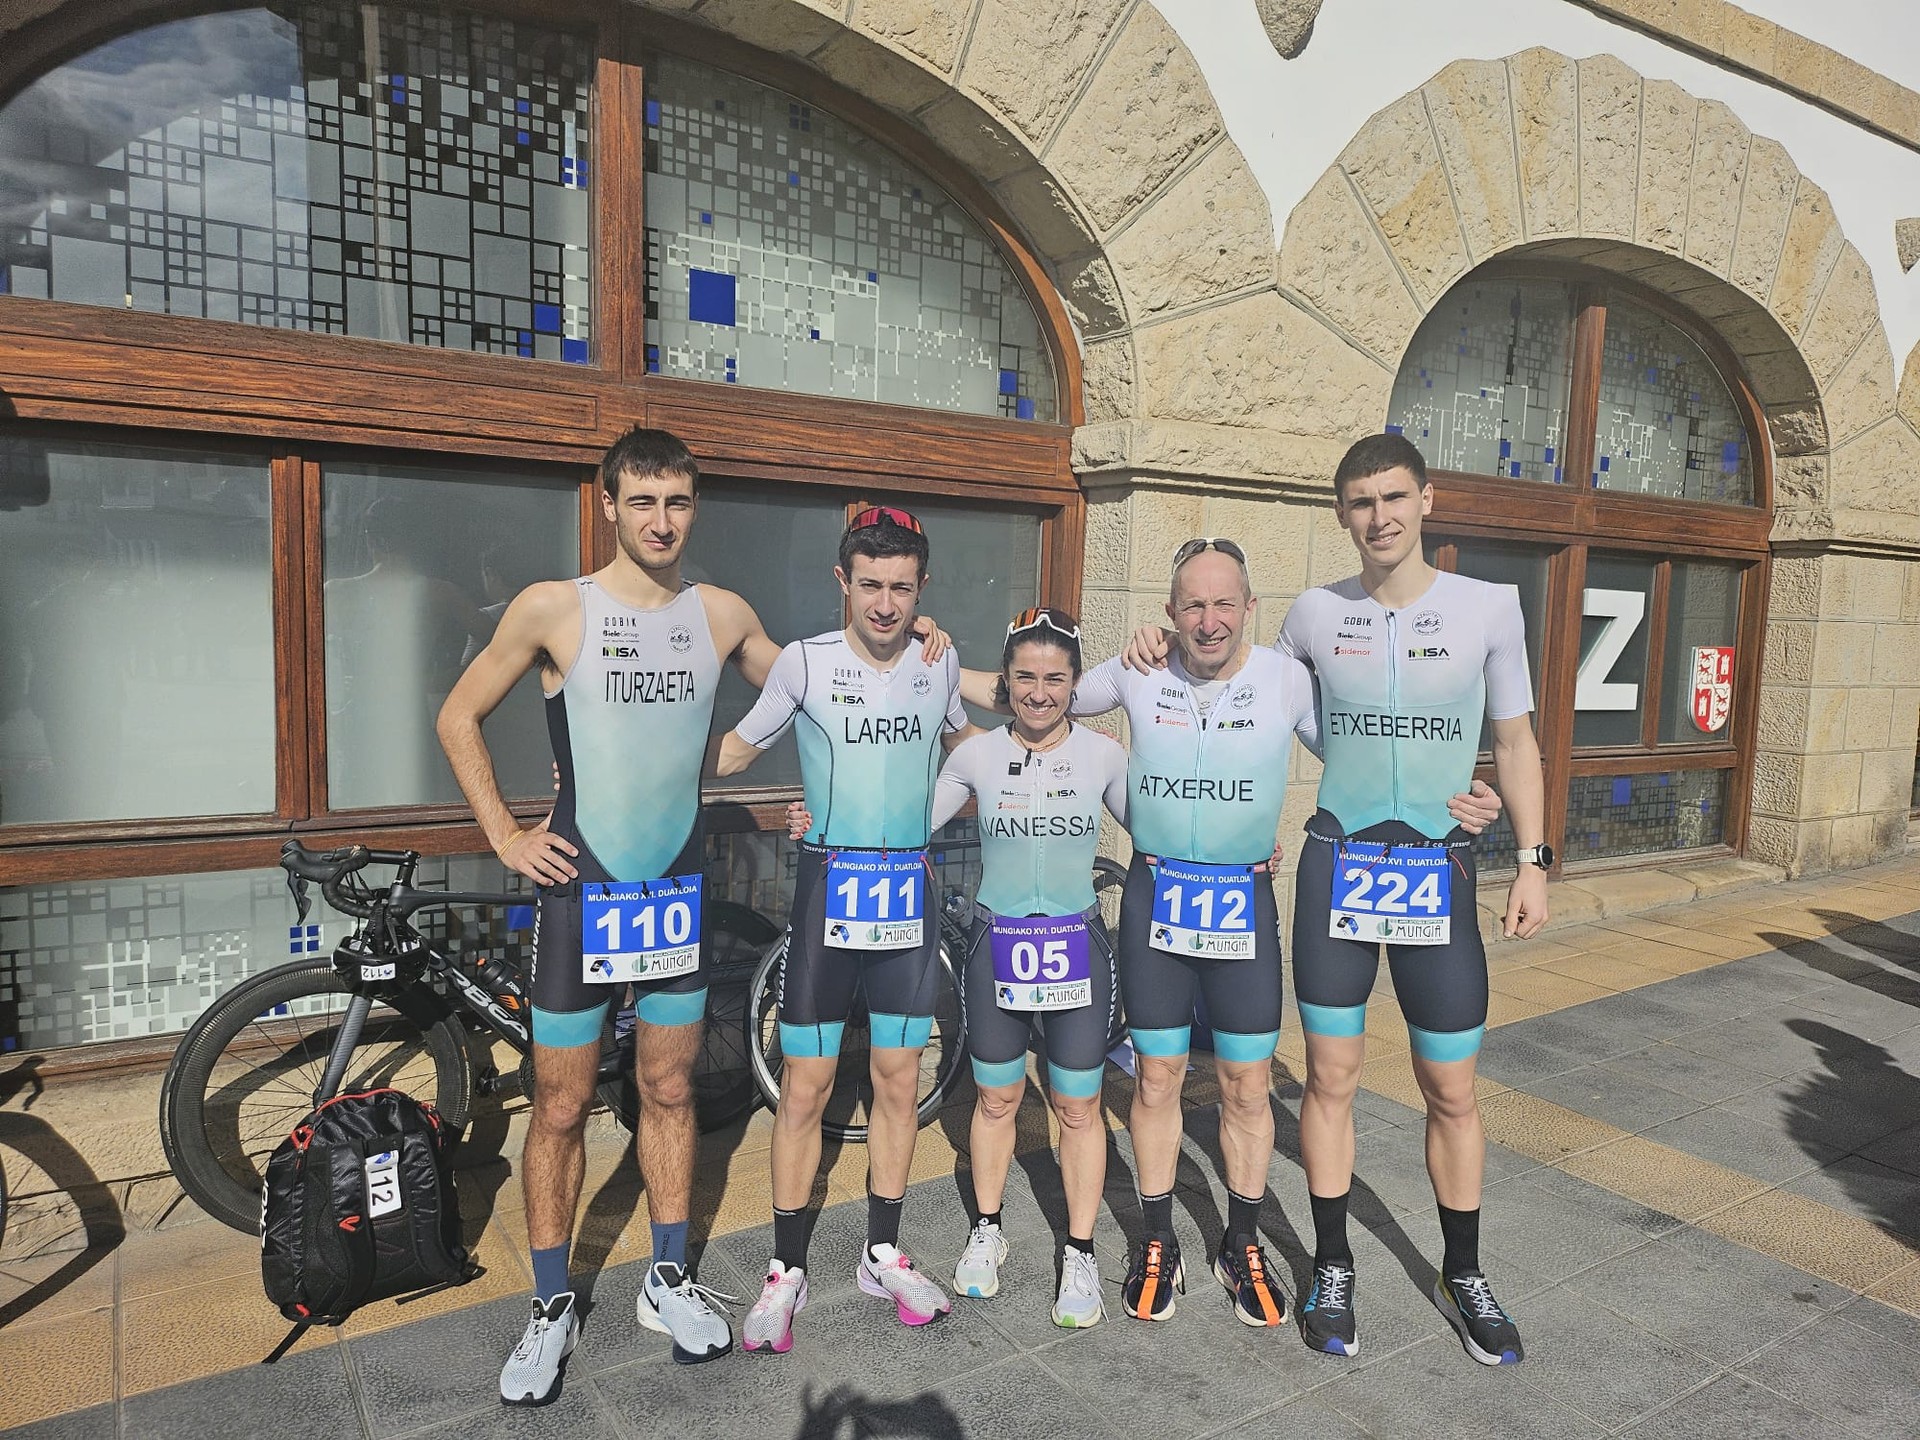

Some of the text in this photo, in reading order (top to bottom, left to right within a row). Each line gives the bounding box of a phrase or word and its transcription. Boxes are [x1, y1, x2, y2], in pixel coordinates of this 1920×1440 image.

[604, 616, 637, 627] GOBIK
[1343, 616, 1372, 628] GOBIK
[605, 670, 695, 704] ITURZAETA
[1160, 687, 1185, 700] GOBIK
[845, 714, 922, 744] LARRA
[1330, 712, 1463, 742] ETXEBERRIA
[1139, 774, 1254, 802] ATXERUE
[984, 815, 1095, 838] VANESSA
[832, 861, 922, 872] MUNGIAKO XVI. DUATLOIA
[1407, 858, 1450, 867] DUATLOIA
[1160, 867, 1200, 882] MUNGIAKO
[1218, 875, 1251, 884] DUATLOIA
[587, 892, 639, 902] MUNGIAKO
[658, 885, 698, 897] DUATLOIA
[837, 876, 915, 919] 111
[1341, 868, 1442, 914] 224
[1163, 884, 1247, 929] 112
[596, 901, 691, 950] 110
[993, 923, 1086, 935] MUNGIAKO XVI. DUATLOIA
[1395, 925, 1442, 938] MUNGIA
[884, 926, 920, 943] MUNGIA
[1206, 939, 1249, 952] MUNGIA
[651, 953, 693, 972] MUNGIA
[1011, 940, 1070, 981] 05
[363, 967, 383, 979] 112
[1046, 988, 1086, 1003] MUNGIA
